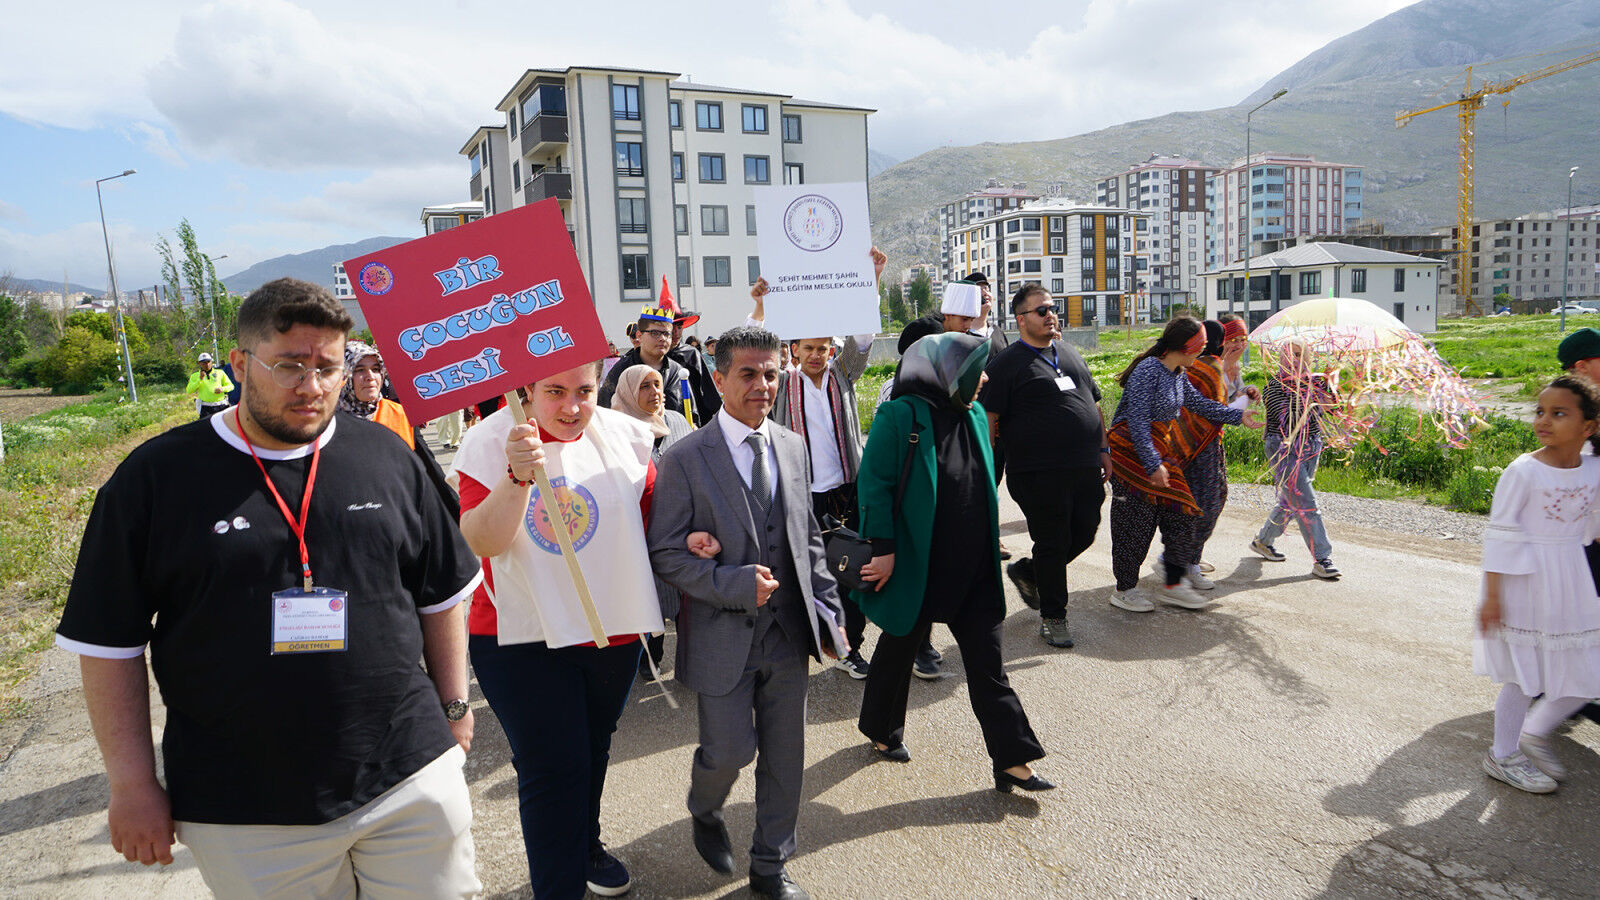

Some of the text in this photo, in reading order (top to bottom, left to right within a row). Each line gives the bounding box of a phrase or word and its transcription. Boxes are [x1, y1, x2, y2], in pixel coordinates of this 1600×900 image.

[435, 256, 502, 296] BİR
[802, 273, 833, 281] MEHMET
[835, 271, 858, 280] ŞAHİN
[814, 282, 844, 290] MESLEK
[399, 279, 563, 359] ÇOCUĞUN
[414, 327, 574, 398] SESİ OL
